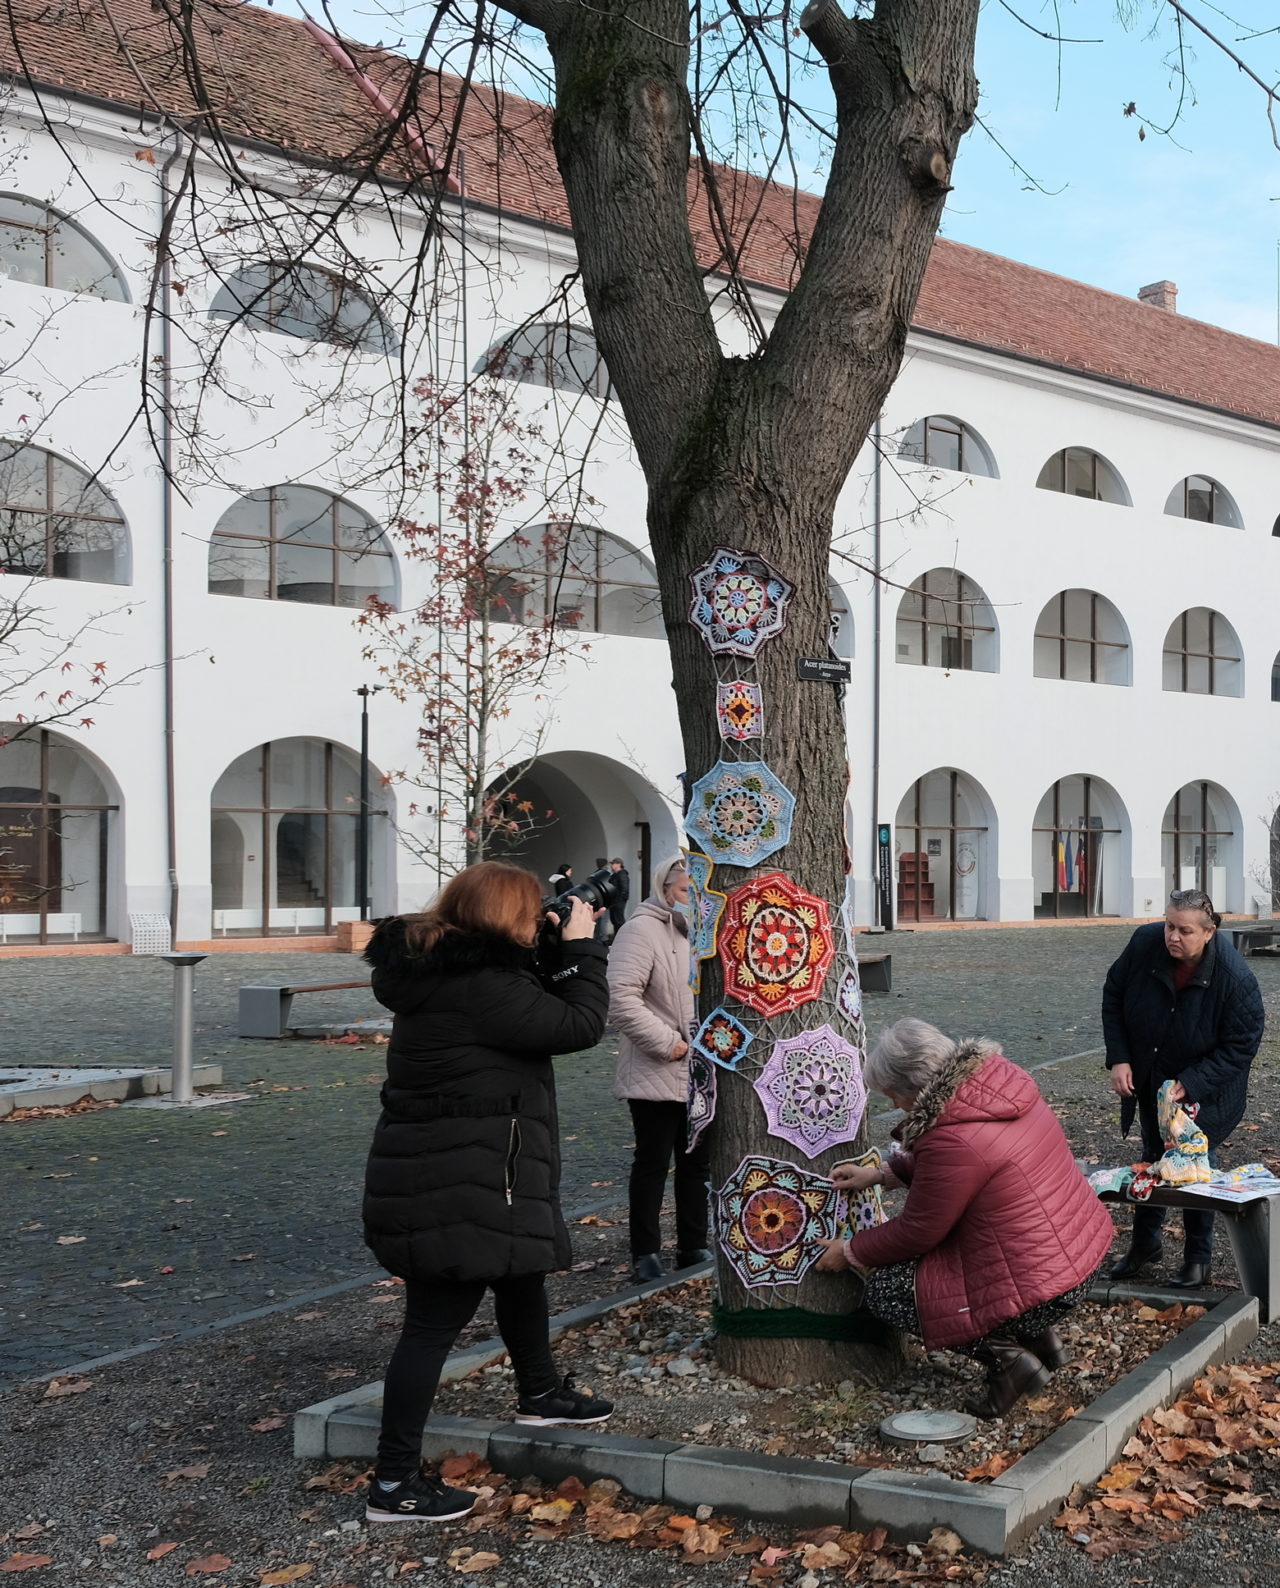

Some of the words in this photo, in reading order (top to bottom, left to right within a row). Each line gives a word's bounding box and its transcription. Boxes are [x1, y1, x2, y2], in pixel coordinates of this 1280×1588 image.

[804, 660, 818, 668] Acer
[552, 965, 579, 981] SONY
[398, 1499, 417, 1511] S
